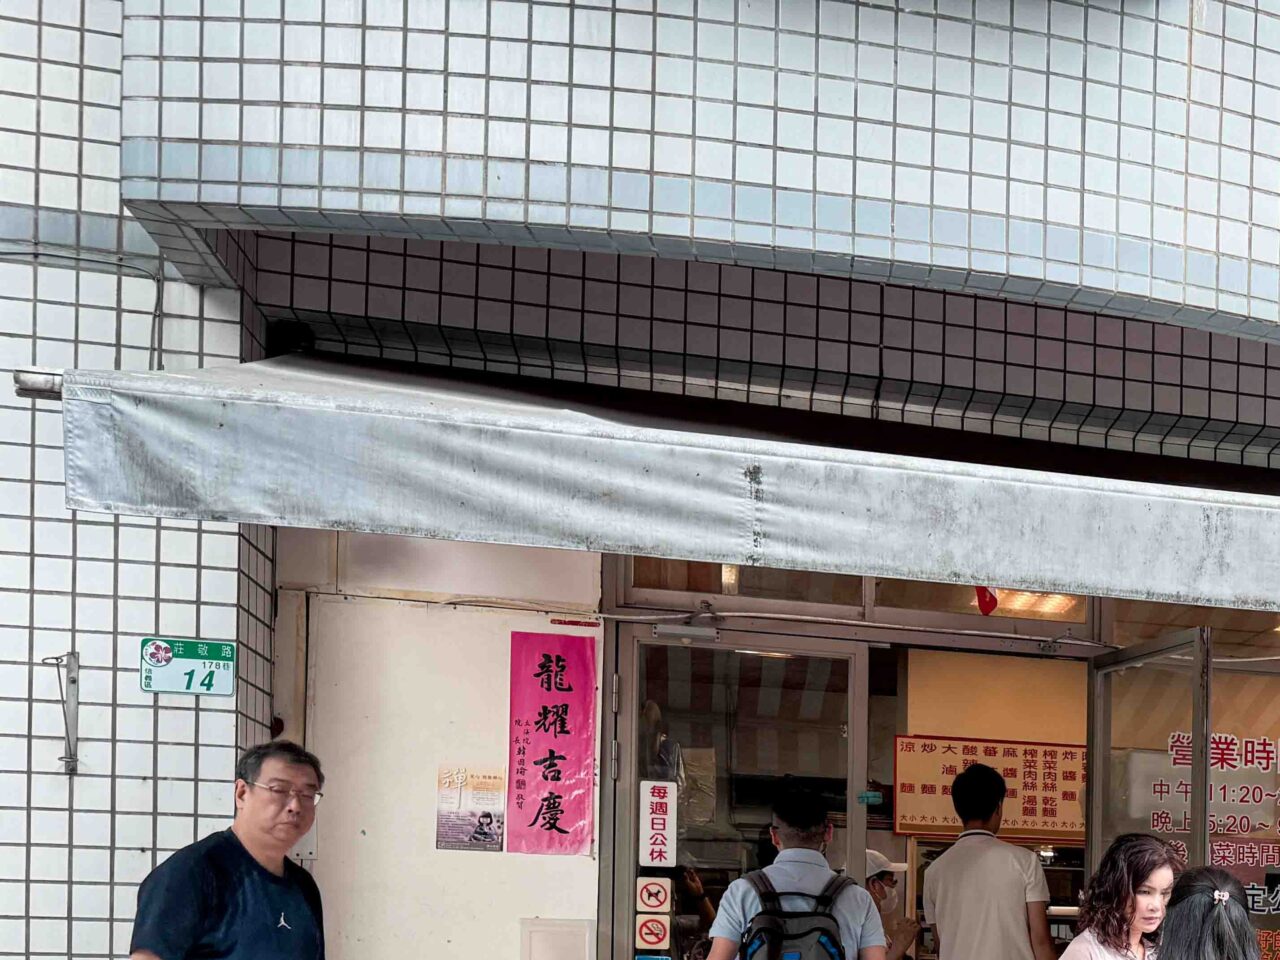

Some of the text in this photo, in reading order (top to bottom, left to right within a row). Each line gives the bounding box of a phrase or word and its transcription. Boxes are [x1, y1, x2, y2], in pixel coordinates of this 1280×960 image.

[173, 642, 232, 658] 莊敬路
[202, 661, 231, 671] 178巷
[184, 669, 216, 692] 14
[528, 653, 573, 835] 龍耀吉慶
[900, 741, 915, 794] 涼麵
[920, 742, 937, 795] 炒麵
[1022, 748, 1038, 817] 榨菜肉絲湯麵
[1042, 749, 1058, 818] 榨菜肉絲乾麵
[1061, 751, 1077, 802] 炸醬麵
[1152, 779, 1192, 803] 中午
[649, 785, 669, 863] 每週日公休
[1151, 810, 1192, 833] 晚上
